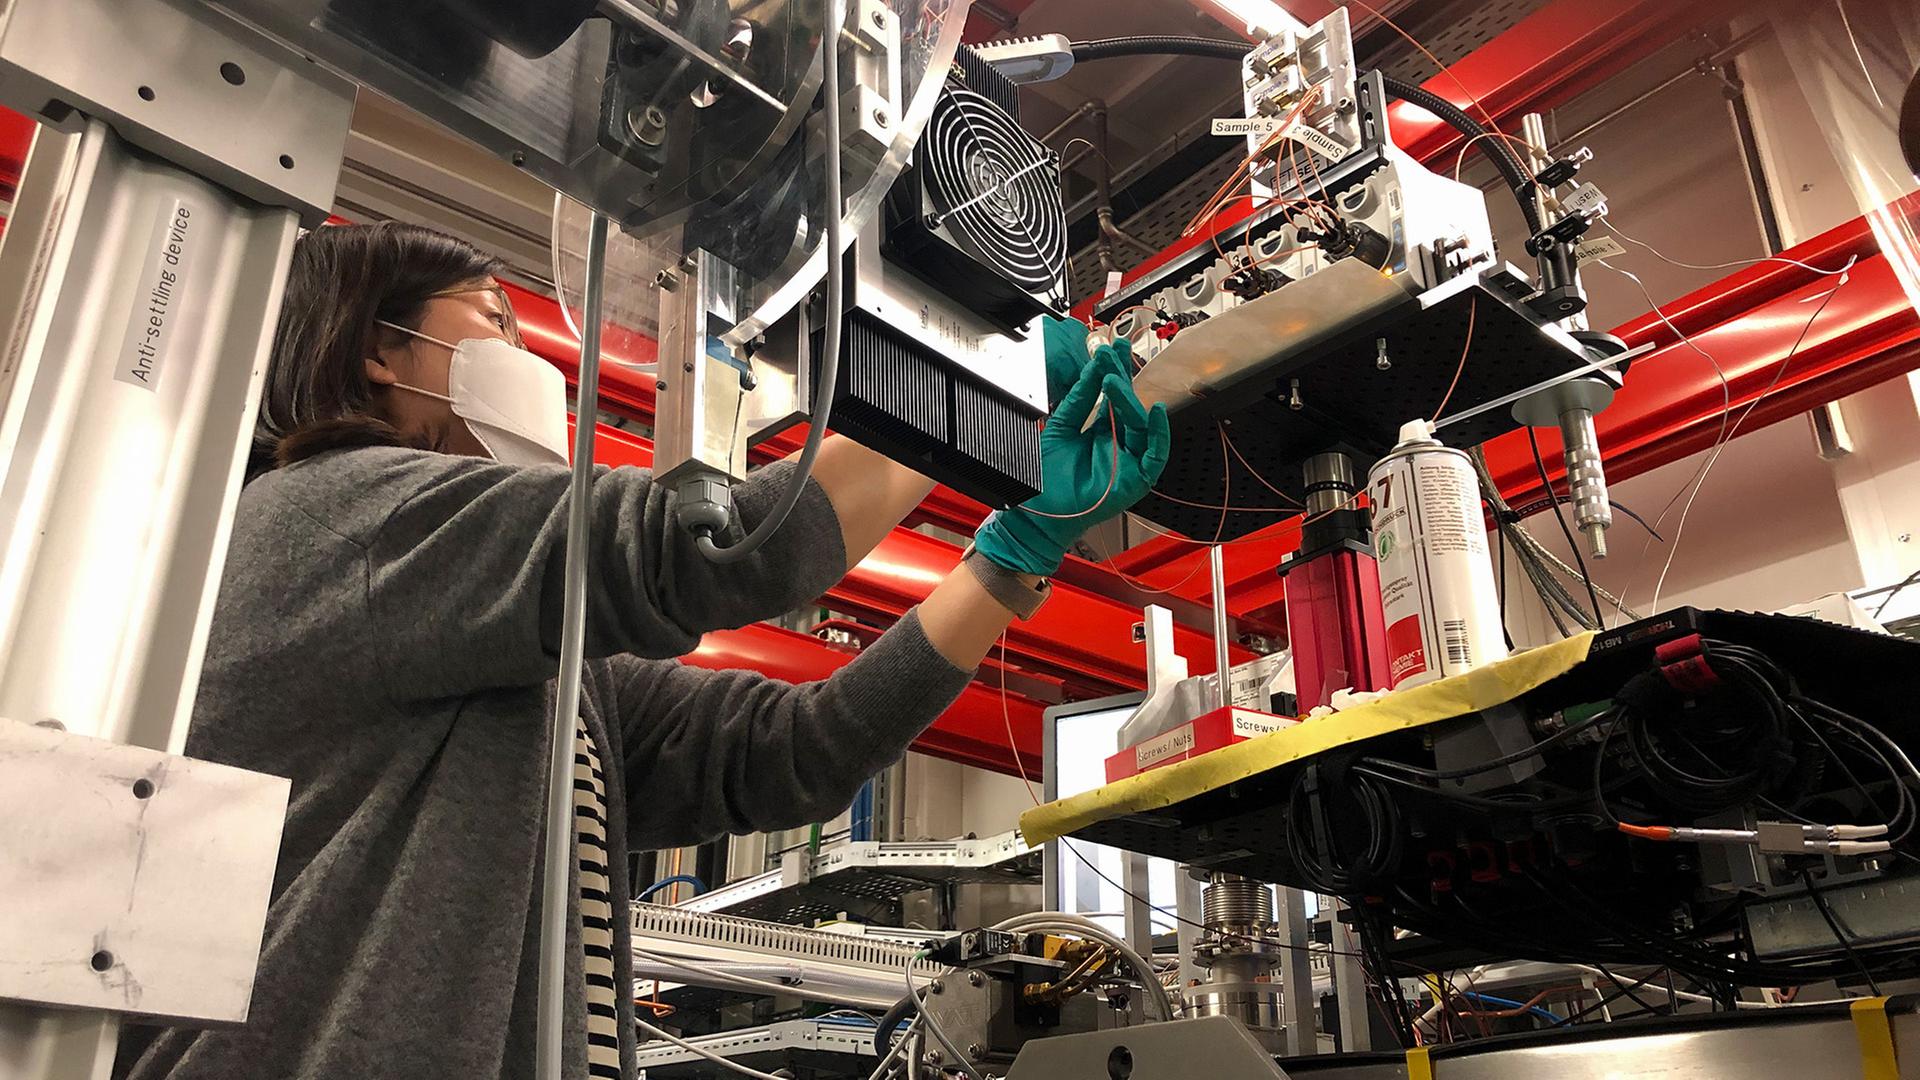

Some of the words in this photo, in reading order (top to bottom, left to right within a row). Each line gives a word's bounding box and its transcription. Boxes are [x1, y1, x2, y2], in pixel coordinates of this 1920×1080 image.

[1215, 122, 1260, 132] Sample
[1265, 122, 1273, 131] 5
[1302, 129, 1343, 159] Sample
[1232, 255, 1240, 268] 3
[132, 269, 177, 383] Anti-settling
[163, 207, 191, 266] device
[1159, 297, 1167, 309] 2
[1590, 636, 1623, 653] MB15
[1138, 740, 1172, 762] Screws/
[1173, 733, 1192, 748] Nuts
